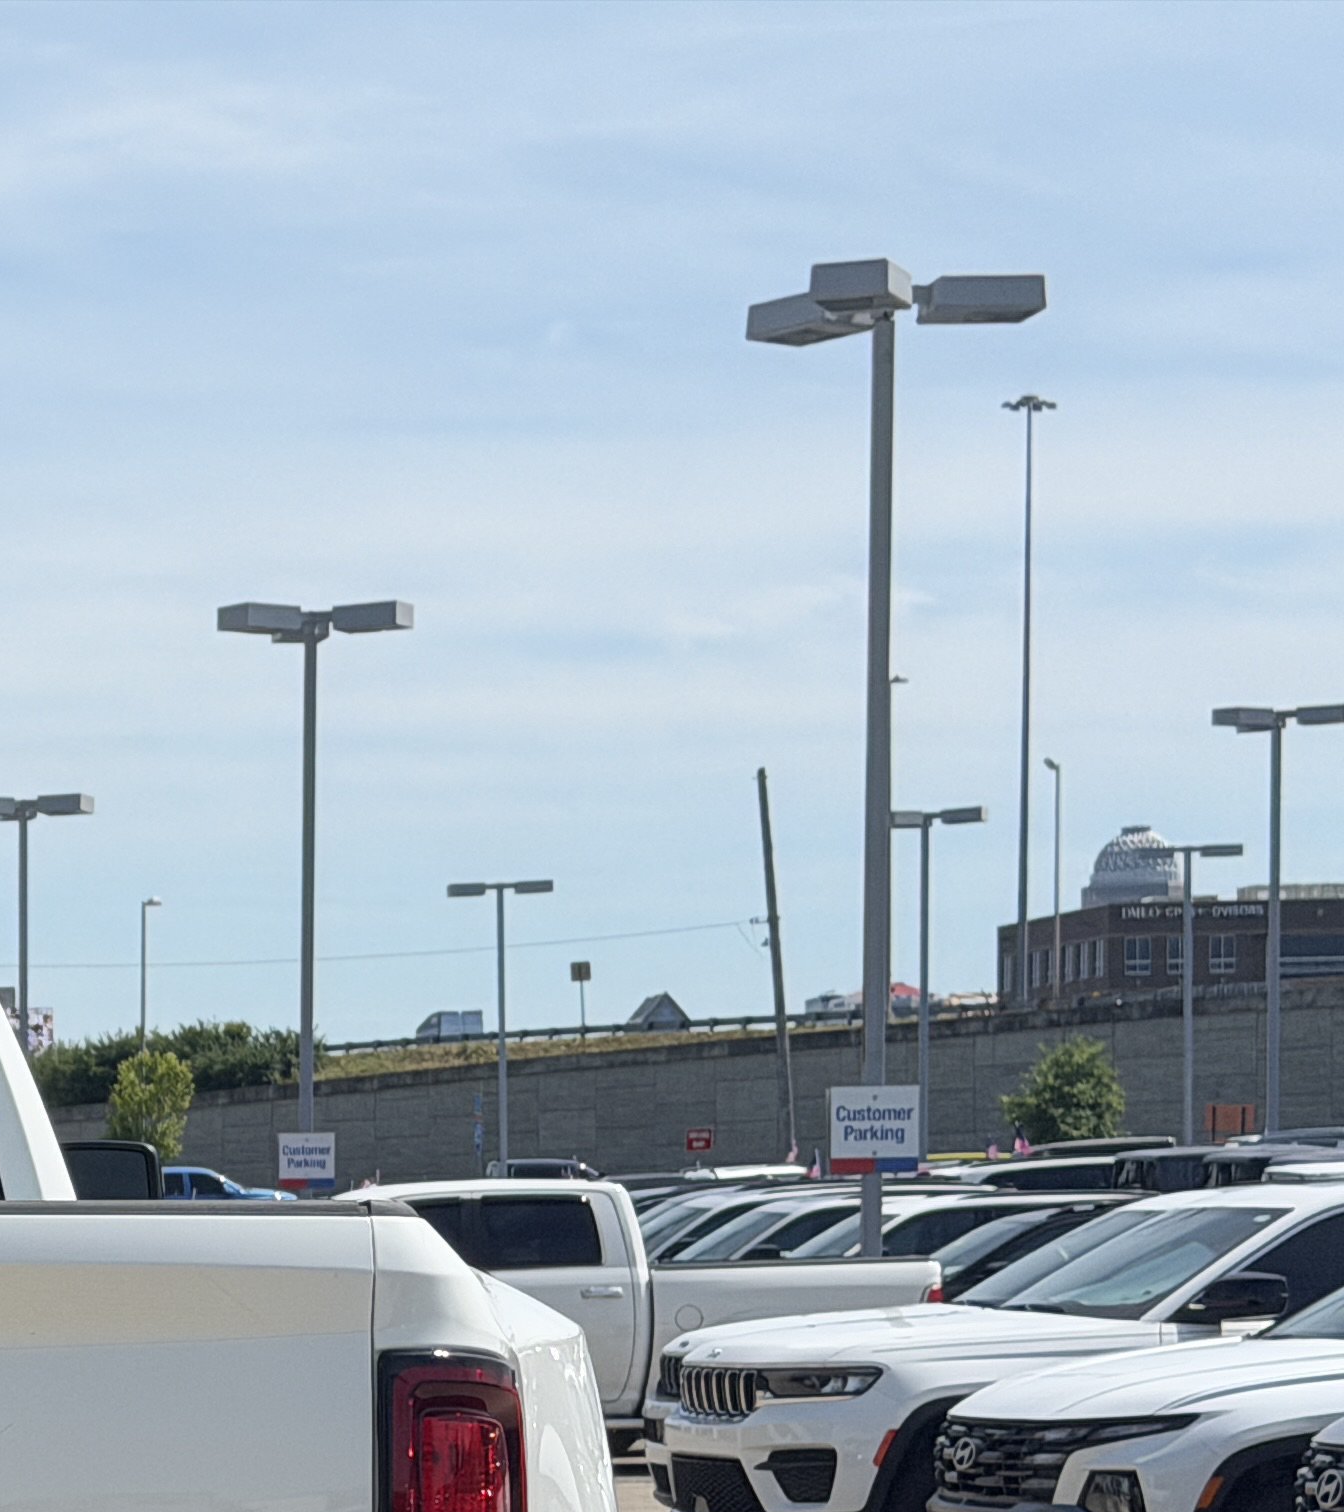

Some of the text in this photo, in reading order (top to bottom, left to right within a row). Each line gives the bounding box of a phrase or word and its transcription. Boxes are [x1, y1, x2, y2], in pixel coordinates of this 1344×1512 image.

[835, 1105, 914, 1122] Customer
[843, 1124, 906, 1144] Parking
[282, 1144, 331, 1156] Customer
[287, 1157, 327, 1170] Parking
